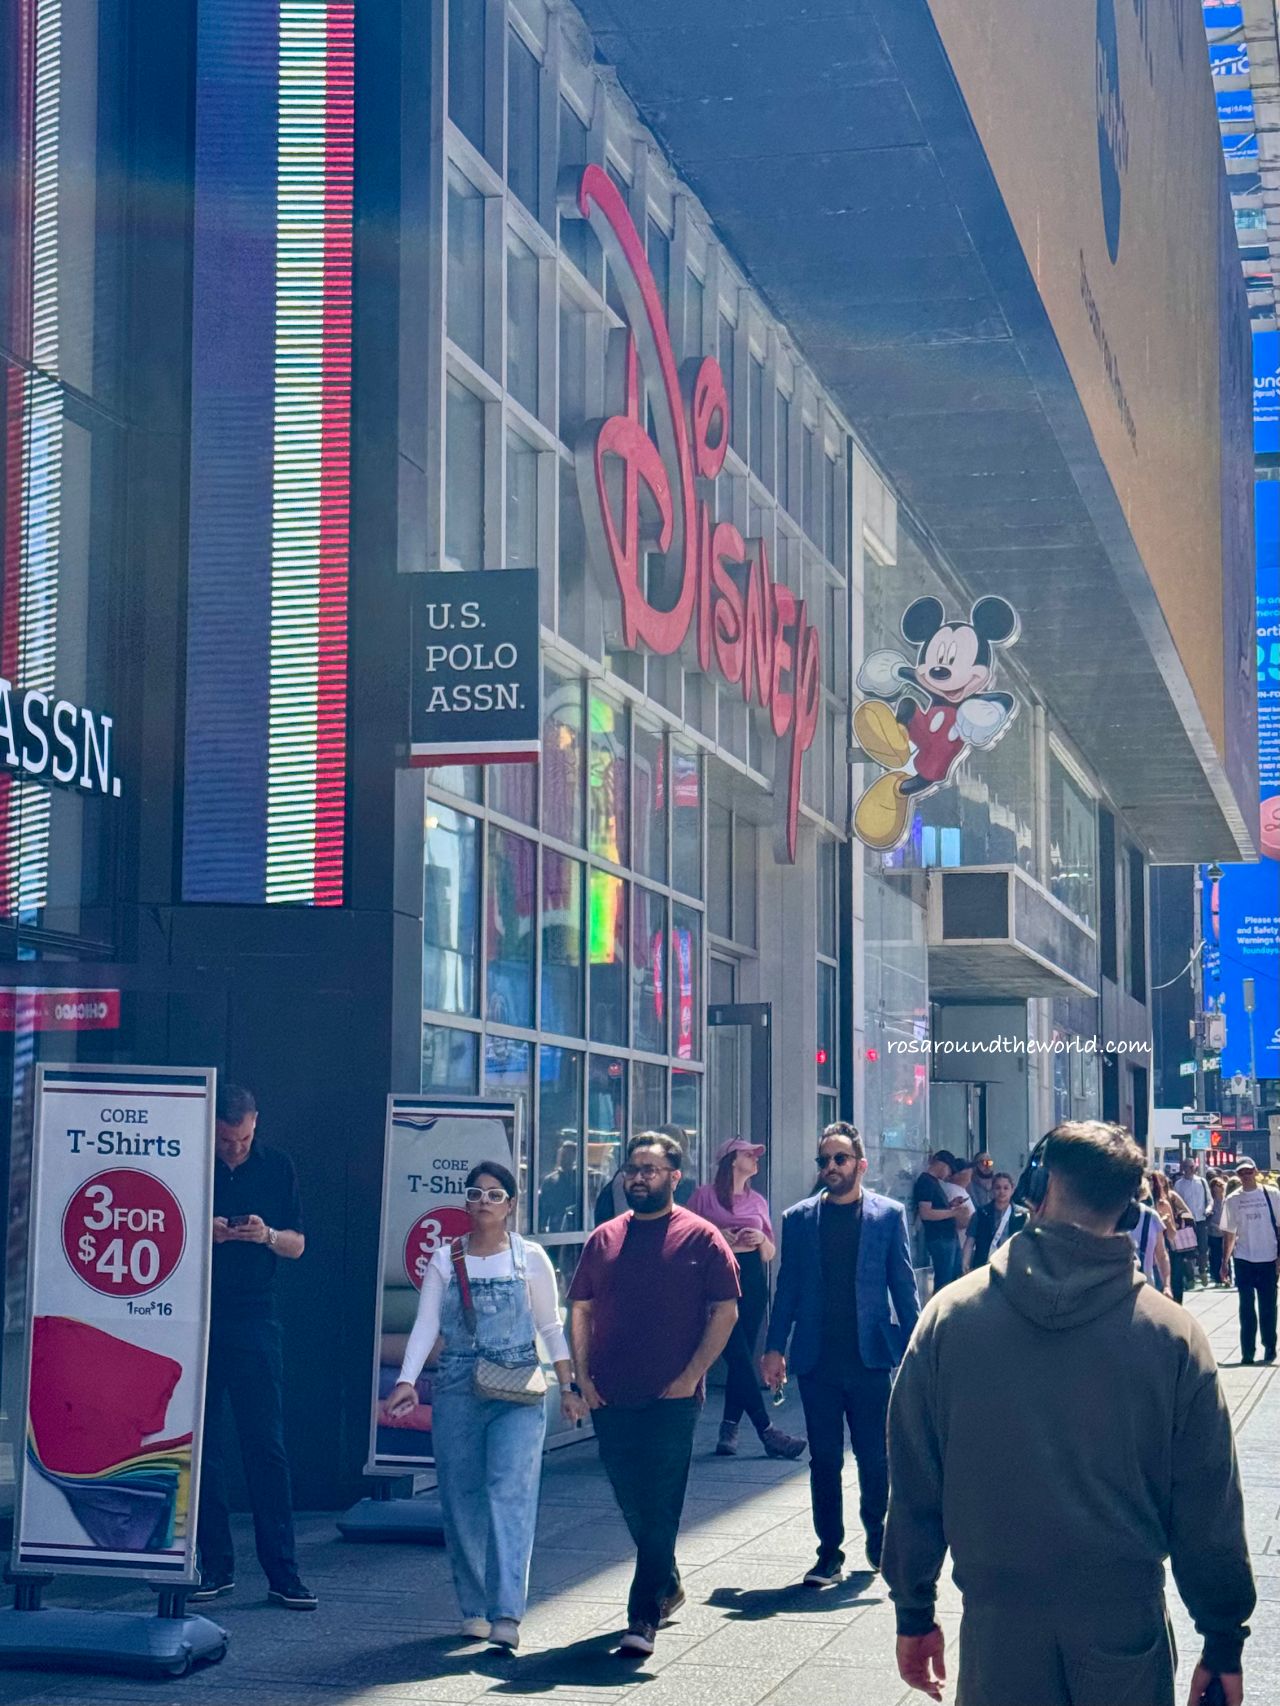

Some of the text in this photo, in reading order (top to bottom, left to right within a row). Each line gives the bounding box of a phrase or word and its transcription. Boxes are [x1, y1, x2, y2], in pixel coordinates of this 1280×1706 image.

[426, 602, 486, 629] U.S.
[426, 643, 518, 672] POLO
[426, 683, 525, 712] ASSN.
[1244, 916, 1271, 924] Please
[1236, 936, 1274, 945] Warnings
[1237, 926, 1278, 935] and Safety
[101, 1108, 149, 1124] CORE
[67, 1129, 181, 1157] T-Shirts
[432, 1159, 469, 1171] CORE
[408, 1174, 467, 1194] T-Shi
[78, 1232, 160, 1285] $40
